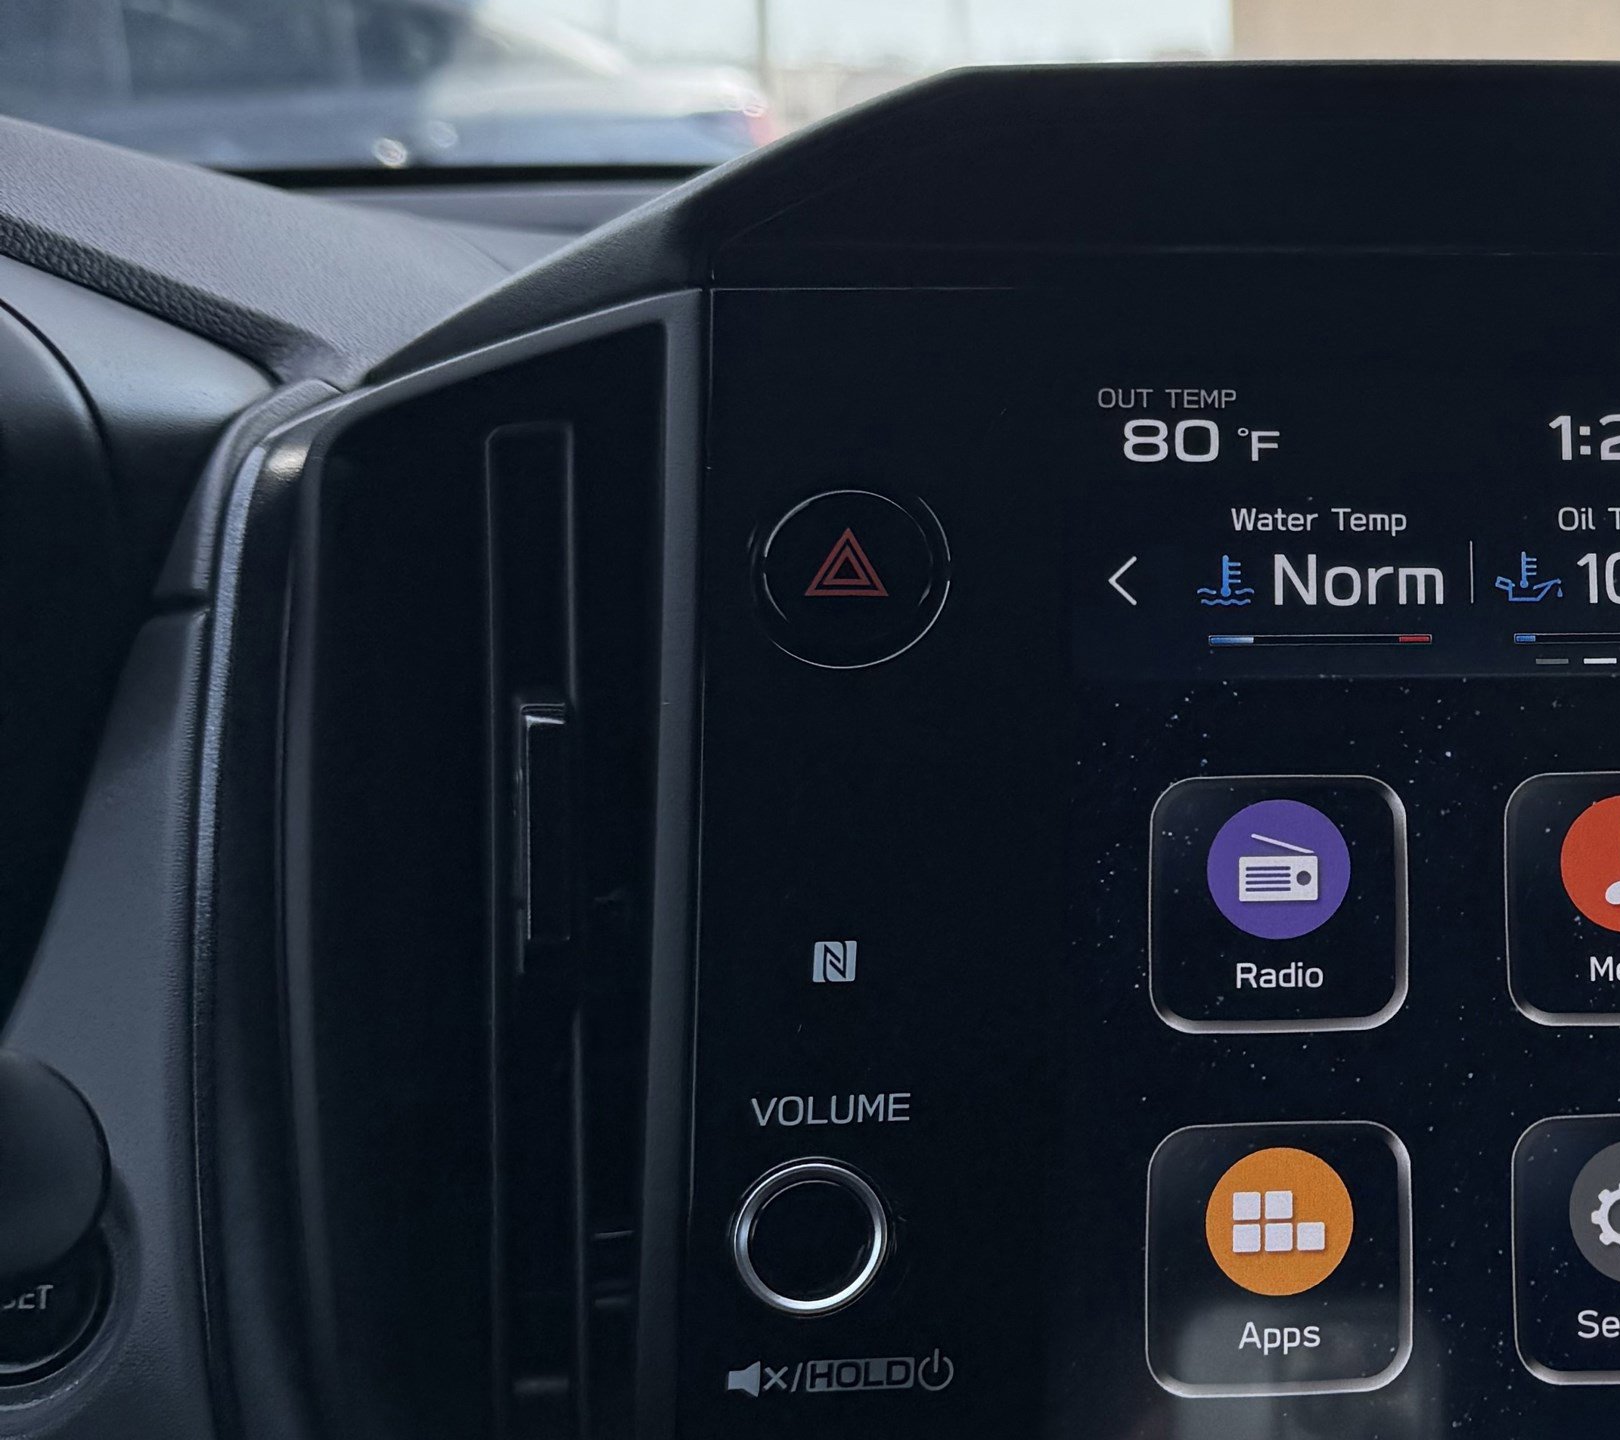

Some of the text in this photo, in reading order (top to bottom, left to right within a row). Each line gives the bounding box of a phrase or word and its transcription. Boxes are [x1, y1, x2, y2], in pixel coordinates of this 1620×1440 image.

[1097, 387, 1237, 409] OUT TEMP
[1123, 418, 1220, 463] 80
[1230, 507, 1407, 537] Water Temp
[1557, 506, 1596, 531] Oil
[1273, 553, 1444, 607] Norm
[1236, 961, 1324, 989] Radio
[750, 1092, 911, 1127] VOLUME
[1238, 1321, 1321, 1356] Apps
[813, 1361, 909, 1387] HOLD
